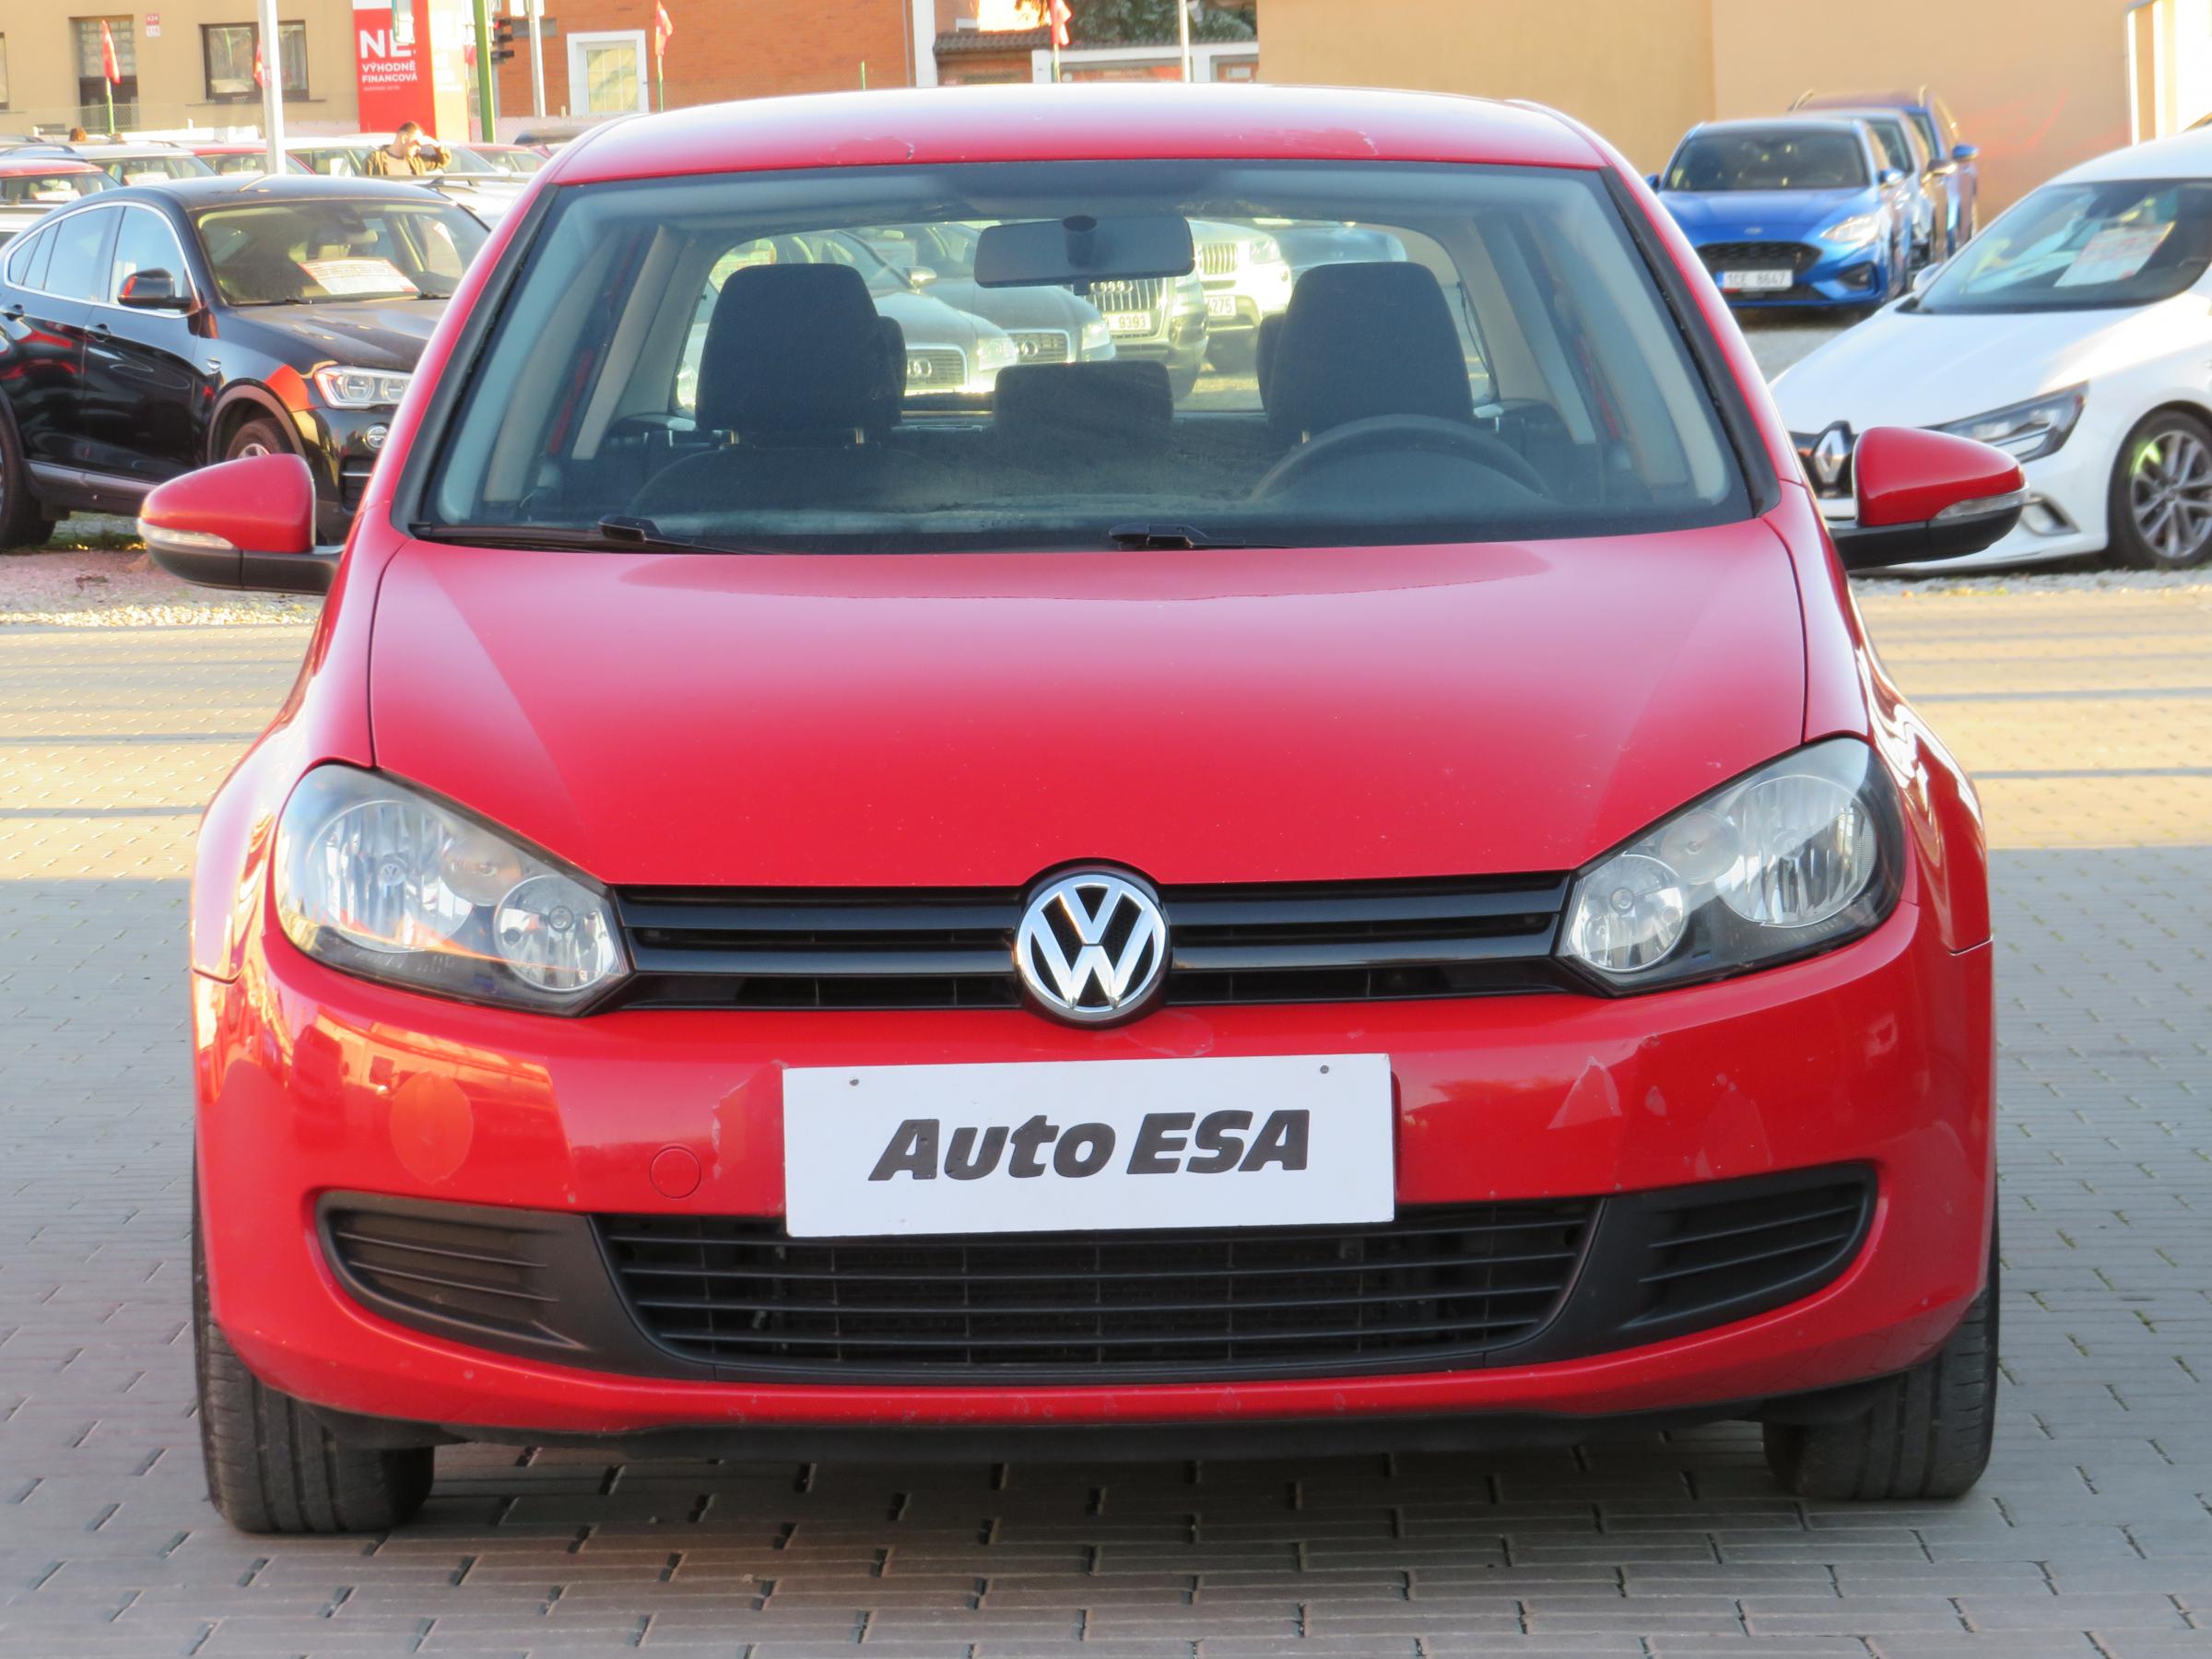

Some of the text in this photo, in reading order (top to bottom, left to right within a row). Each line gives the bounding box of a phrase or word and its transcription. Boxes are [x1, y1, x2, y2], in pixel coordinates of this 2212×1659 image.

[362, 60, 417, 73] VÝHODNĚ
[362, 73, 418, 84] FINANCOVÁ
[1020, 876, 1163, 1017] VW
[868, 1110, 1310, 1181] Auto ESA
